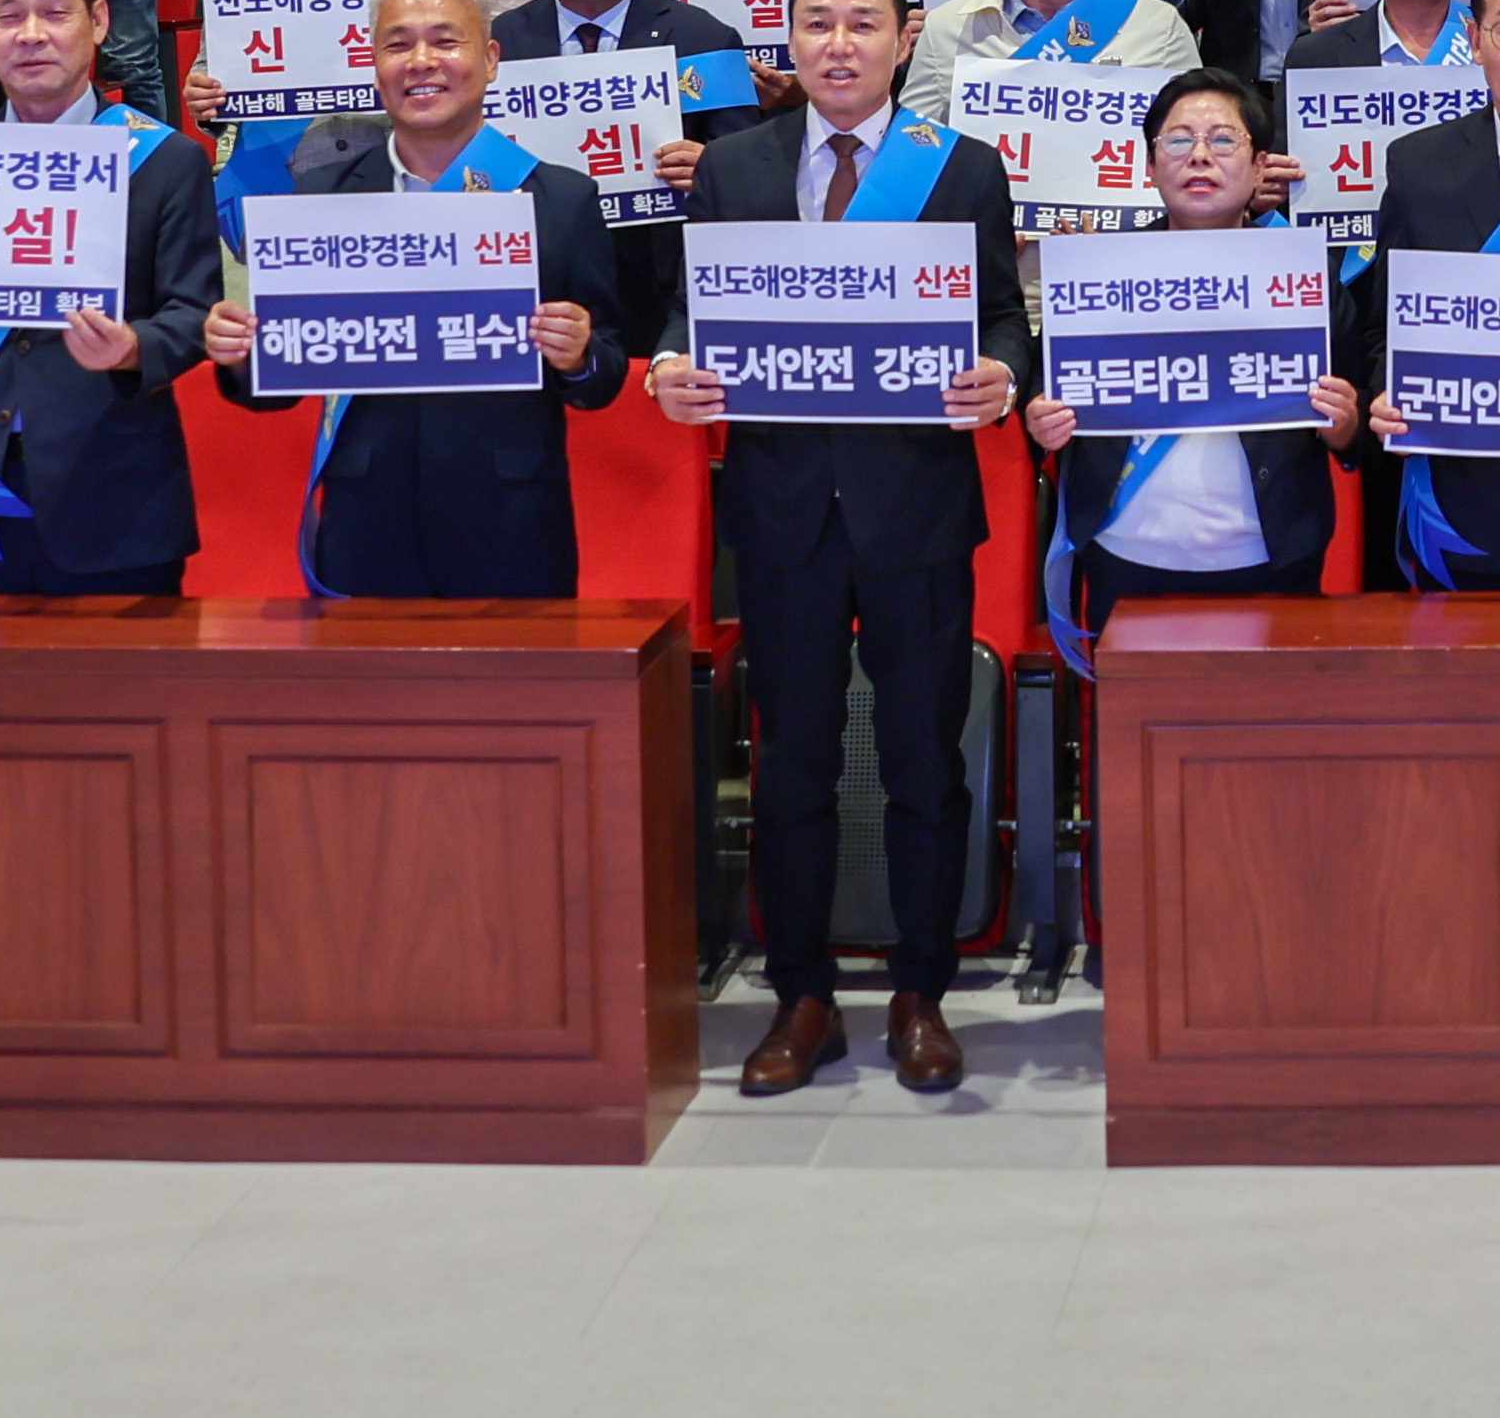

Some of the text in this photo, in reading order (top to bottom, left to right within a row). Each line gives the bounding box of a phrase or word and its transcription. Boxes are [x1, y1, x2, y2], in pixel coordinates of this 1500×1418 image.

[224, 87, 375, 115] 서남해 골든타임
[572, 123, 644, 183] 설!
[1329, 140, 1374, 193] 신
[3, 206, 77, 265] 설!
[254, 231, 533, 270] 진도해양경찰서 신설
[694, 264, 972, 300] 진도해양경찰서 신설
[1048, 272, 1324, 315] 진도해양경찰서 신설
[261, 313, 529, 364] 해양안전 필수!
[699, 344, 965, 392] 도서안전 강화!
[1051, 352, 1325, 408] 골든타임 확보!
